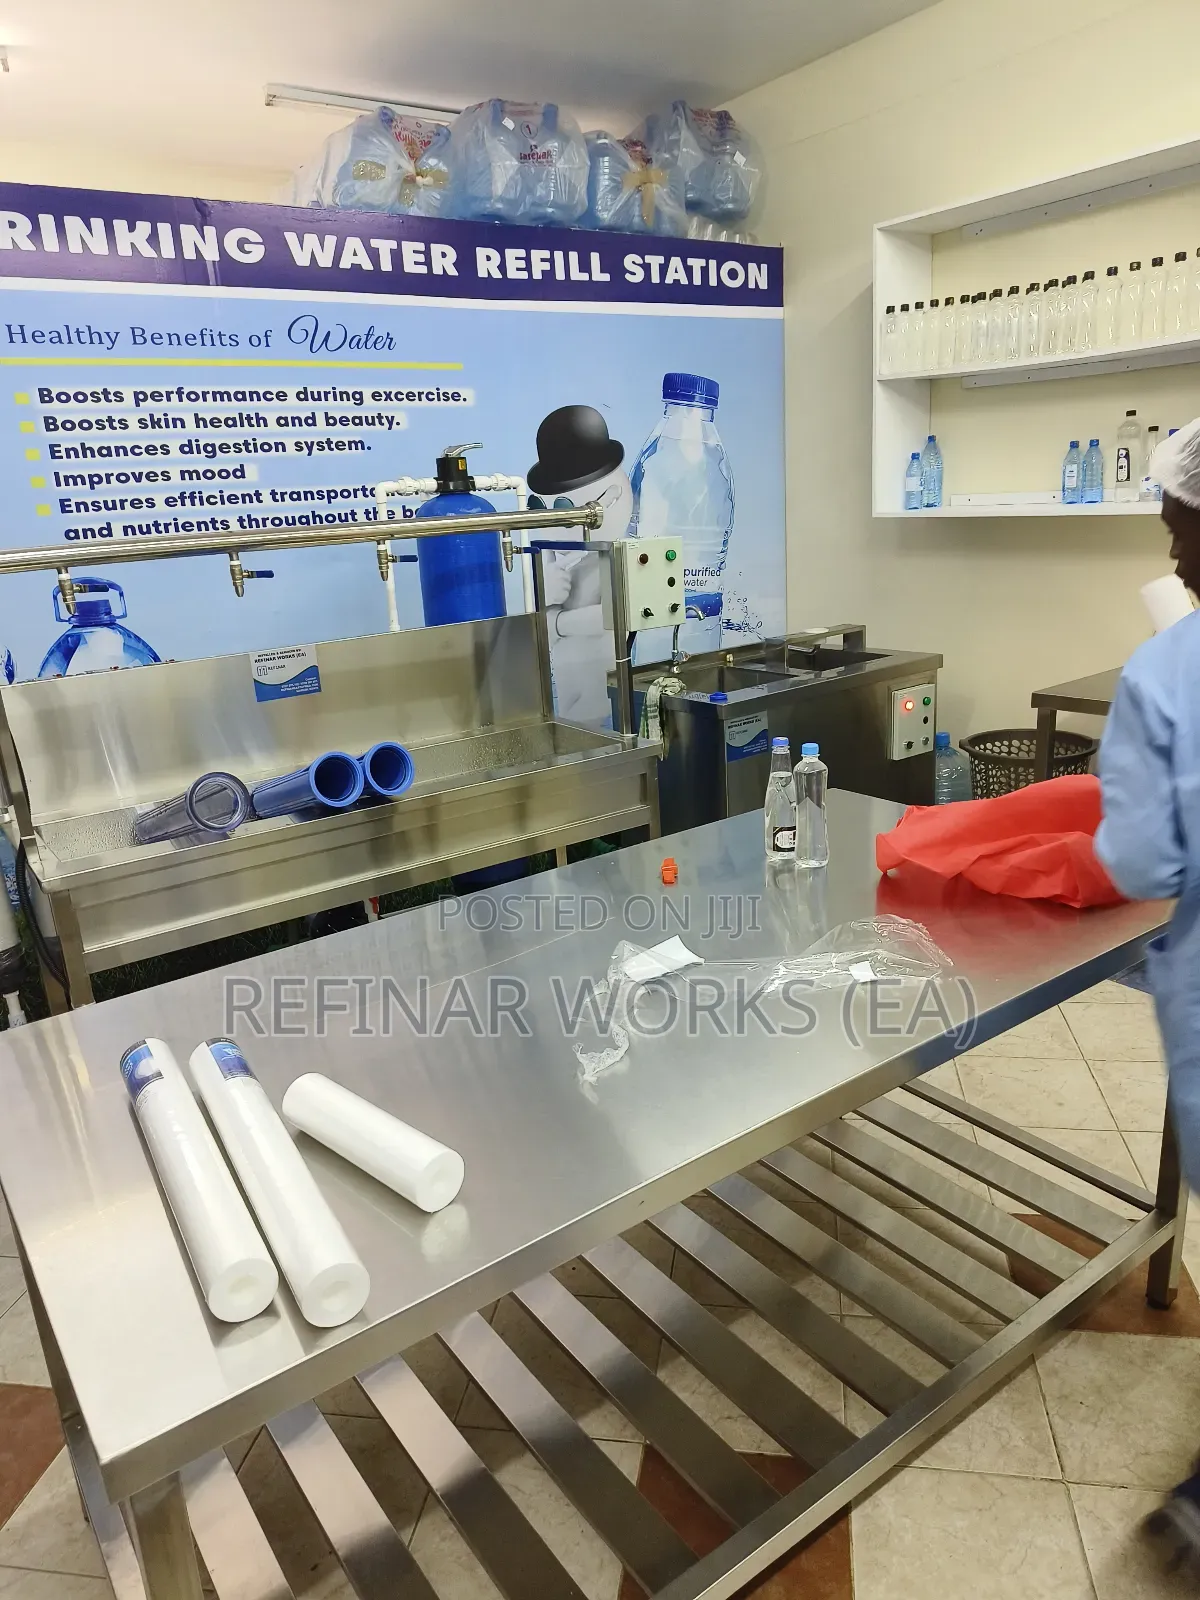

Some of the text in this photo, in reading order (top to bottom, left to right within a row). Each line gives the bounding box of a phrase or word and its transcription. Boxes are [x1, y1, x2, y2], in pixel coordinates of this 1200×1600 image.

[0, 210, 768, 290] RINKING WATER REFILL STATION
[5, 314, 397, 354] Healthy Benefits of Water
[38, 386, 468, 407] Boosts performance during excercise.
[44, 412, 401, 433] Boosts skin health and beauty.
[49, 437, 372, 460] Enhances digestion system.
[53, 464, 246, 490] Improves mood
[59, 498, 156, 514] Ensures
[164, 490, 263, 508] efficient
[63, 523, 114, 541] and
[122, 517, 231, 537] nutrients
[683, 566, 721, 578] purified
[684, 579, 708, 587] water
